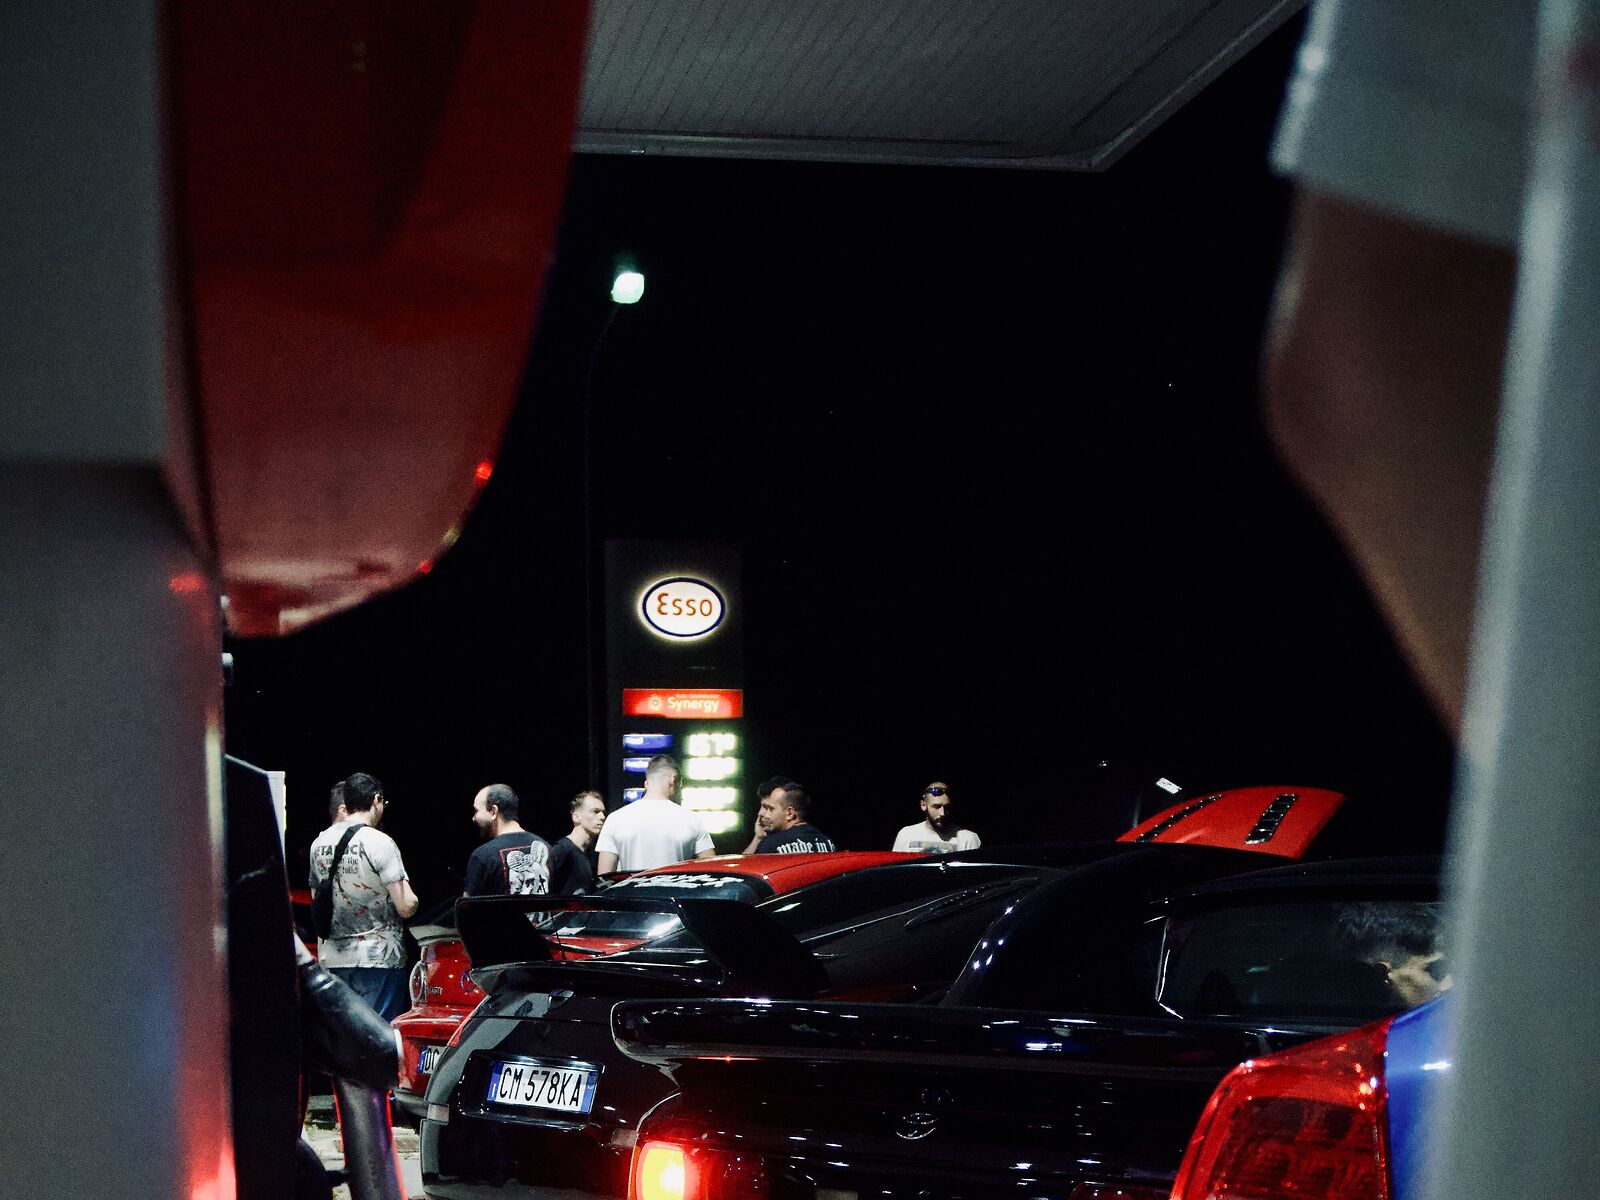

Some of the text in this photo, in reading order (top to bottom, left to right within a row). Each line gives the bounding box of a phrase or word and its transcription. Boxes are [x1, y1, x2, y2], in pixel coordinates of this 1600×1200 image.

[667, 697, 720, 713] Synergy
[777, 838, 814, 854] made
[815, 838, 829, 853] in
[499, 1067, 582, 1107] CM 578KA
